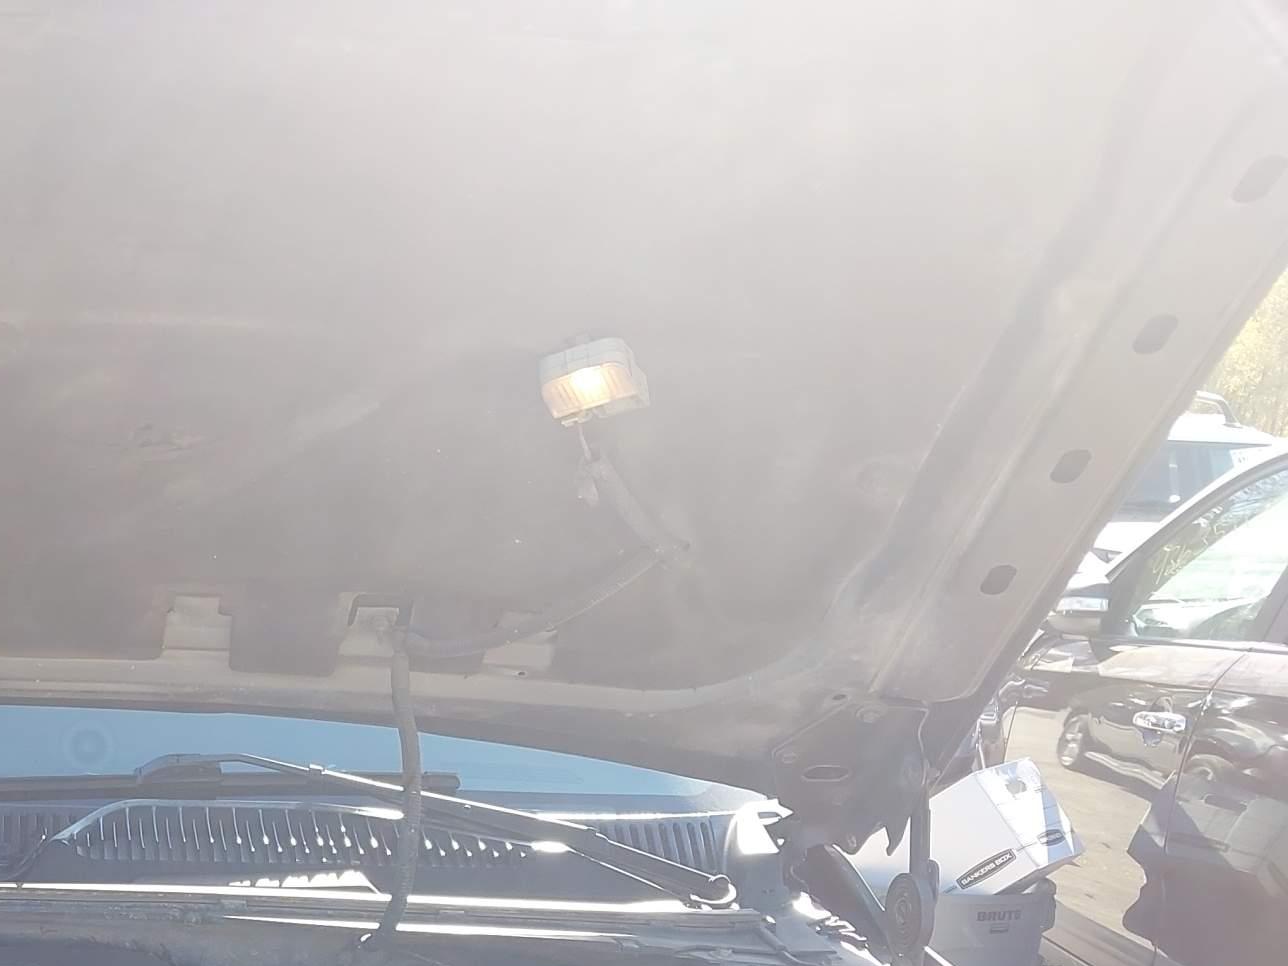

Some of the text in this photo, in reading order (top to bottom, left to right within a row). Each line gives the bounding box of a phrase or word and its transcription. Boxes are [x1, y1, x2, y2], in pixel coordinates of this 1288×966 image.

[961, 852, 1014, 885] BANKERS BOX
[976, 910, 1022, 922] BRUTE
